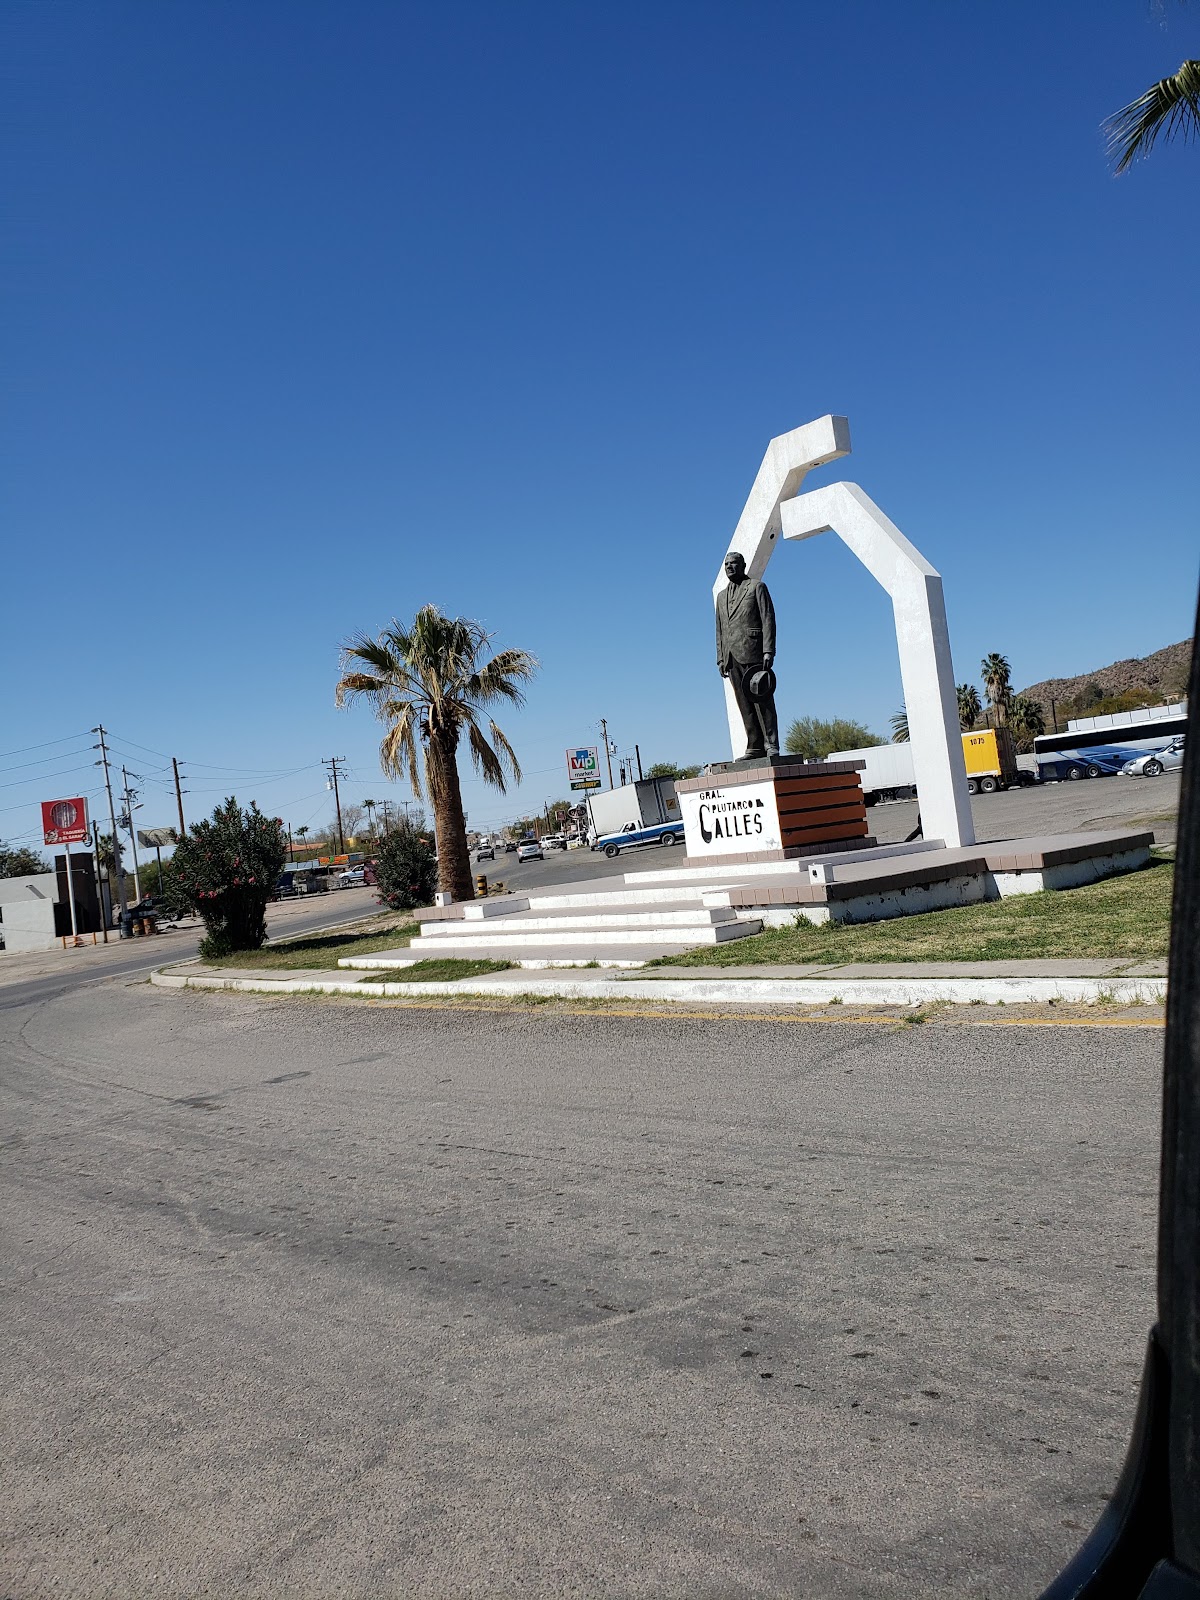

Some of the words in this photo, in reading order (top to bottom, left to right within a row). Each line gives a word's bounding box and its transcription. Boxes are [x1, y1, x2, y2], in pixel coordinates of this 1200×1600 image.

[573, 755, 593, 768] vip
[574, 781, 599, 789] SUBWAY
[699, 790, 725, 800] GRAL.
[712, 799, 753, 814] PLUTARCO
[699, 803, 763, 844] CALLES
